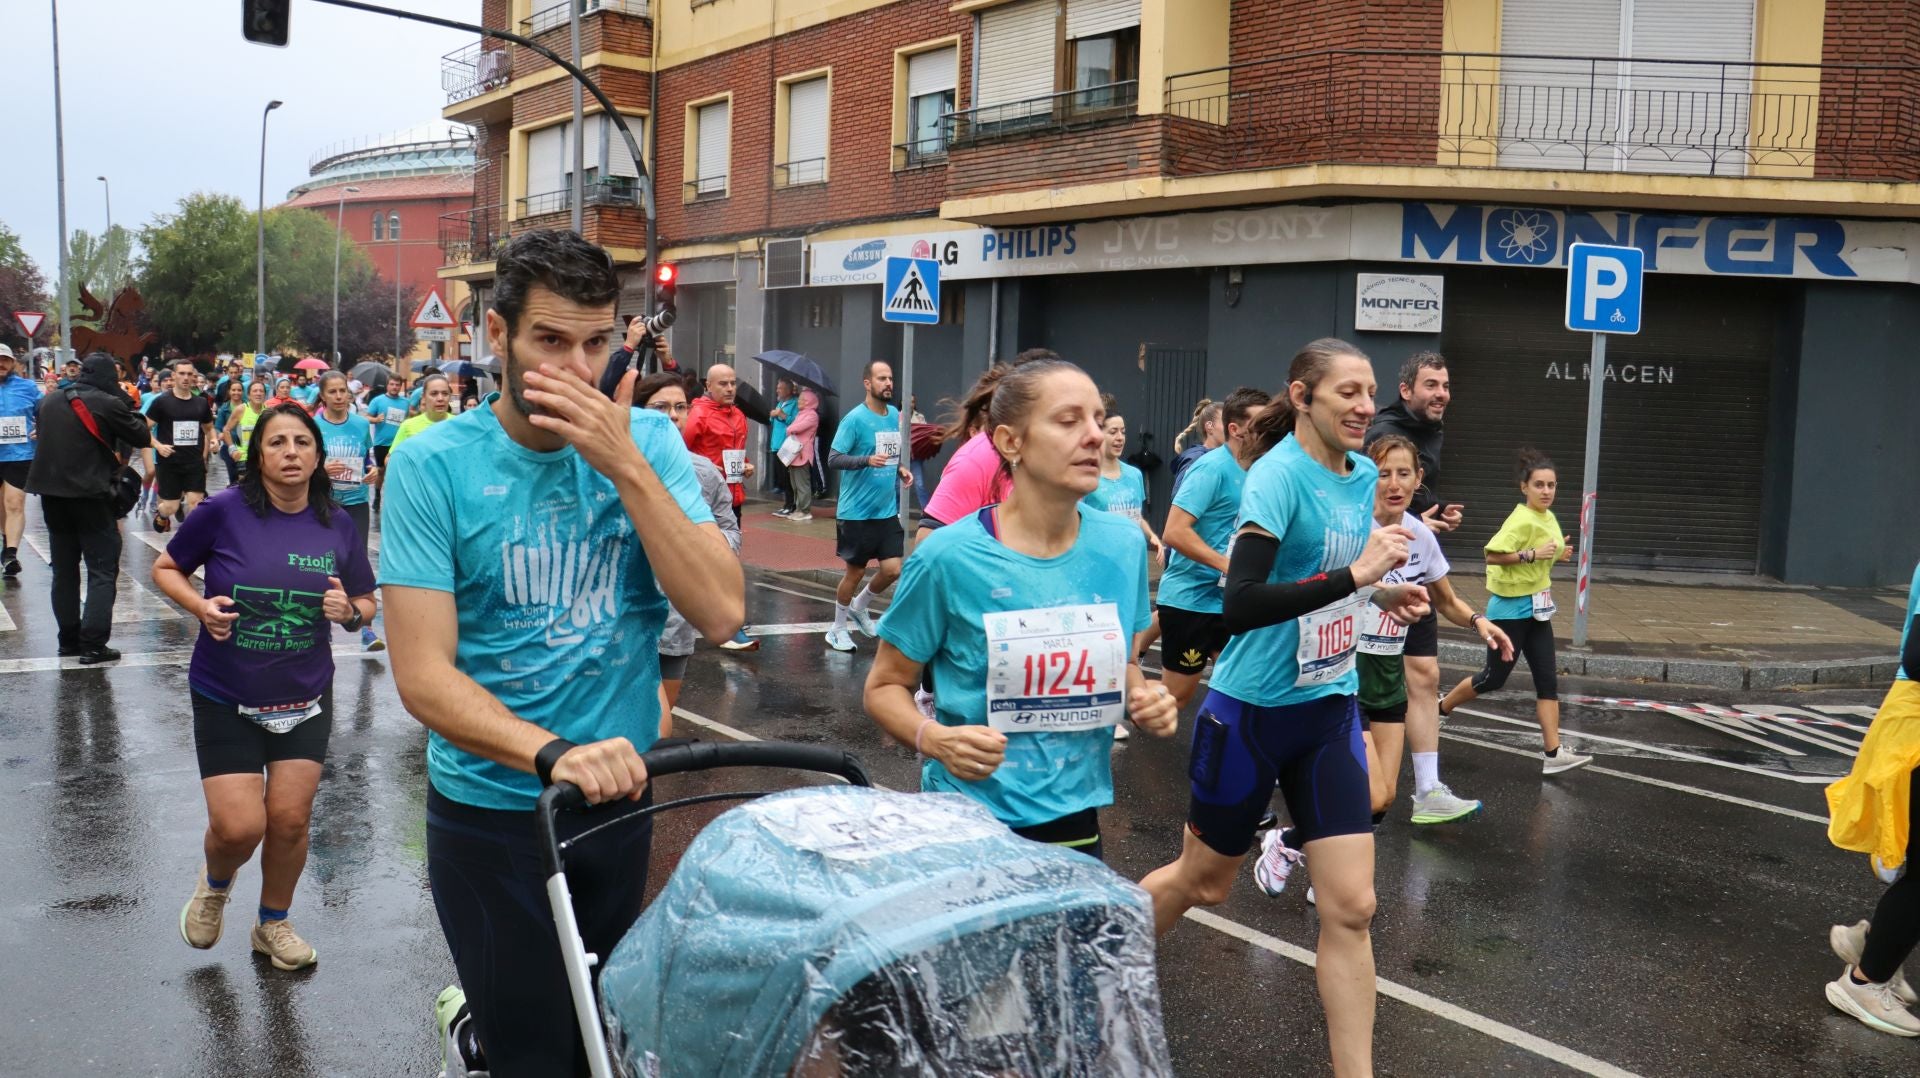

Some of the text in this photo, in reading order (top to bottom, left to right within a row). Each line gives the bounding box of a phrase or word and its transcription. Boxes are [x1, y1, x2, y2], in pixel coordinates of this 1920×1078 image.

[847, 211, 1333, 266] SAMSUN LG PHILIPS JVC SONY
[1401, 202, 1858, 278] MONFER
[1098, 253, 1190, 270] TECNICA
[812, 271, 877, 285] SERVICIO
[1583, 254, 1629, 321] P
[1361, 297, 1440, 311] MONFER
[2, 425, 21, 436] 956
[882, 443, 897, 456] 785
[504, 617, 547, 630] Hyunda
[236, 633, 281, 651] Carreira
[1316, 615, 1353, 659] 1109
[1023, 649, 1097, 697] 1124
[1040, 709, 1103, 722] HYUNDAI
